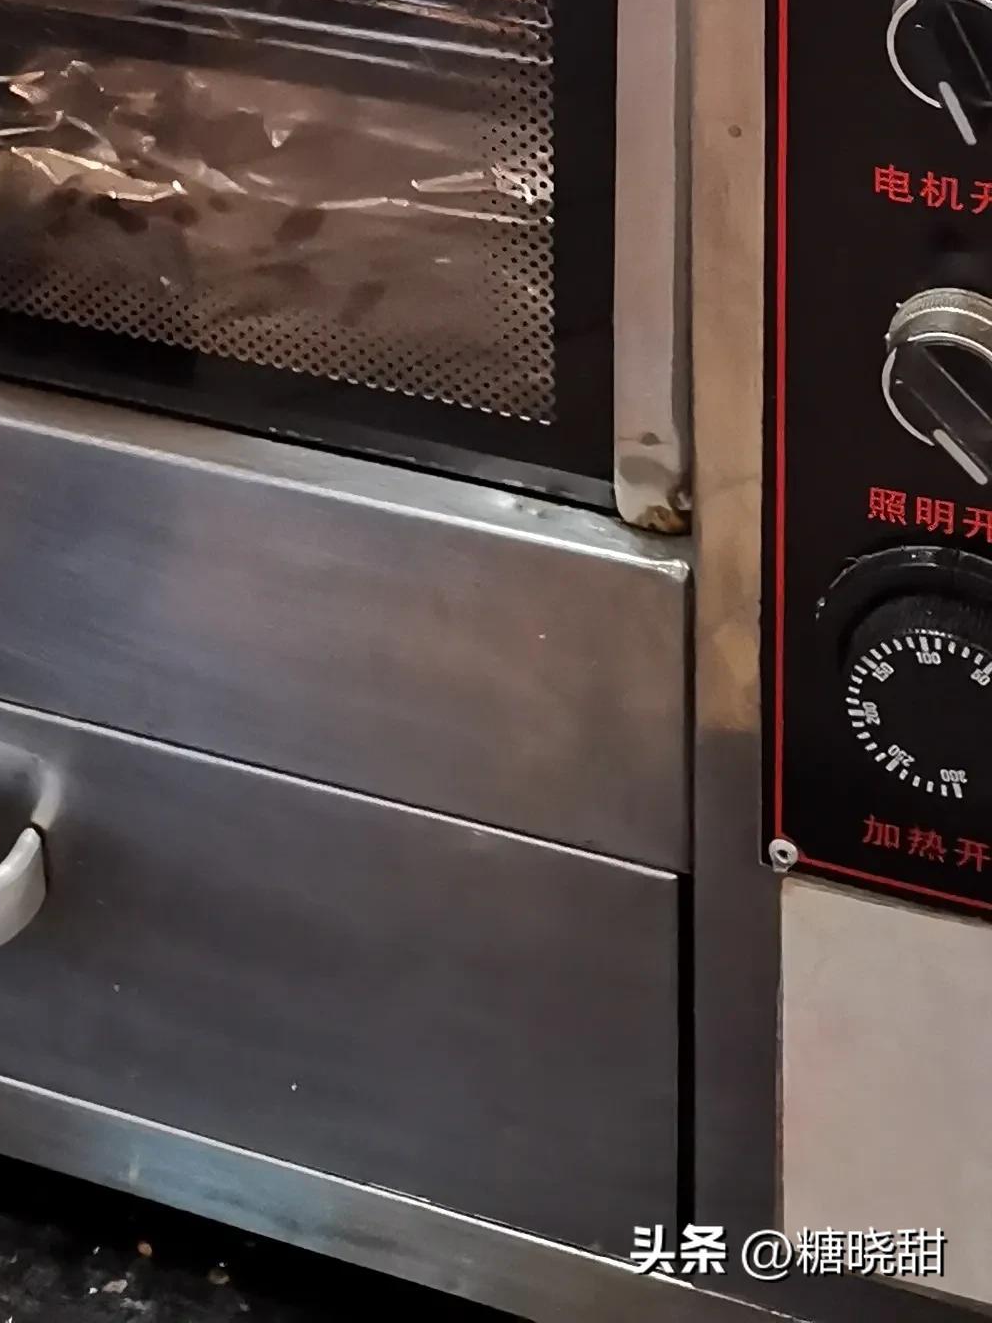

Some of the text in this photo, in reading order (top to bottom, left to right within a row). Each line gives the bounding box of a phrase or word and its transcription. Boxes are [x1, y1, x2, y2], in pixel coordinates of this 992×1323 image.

[916, 651, 941, 665] 100
[872, 662, 894, 682] 150
[970, 668, 990, 686] 50
[862, 701, 880, 725] 200
[887, 744, 915, 767] 250
[940, 769, 968, 783] 300
